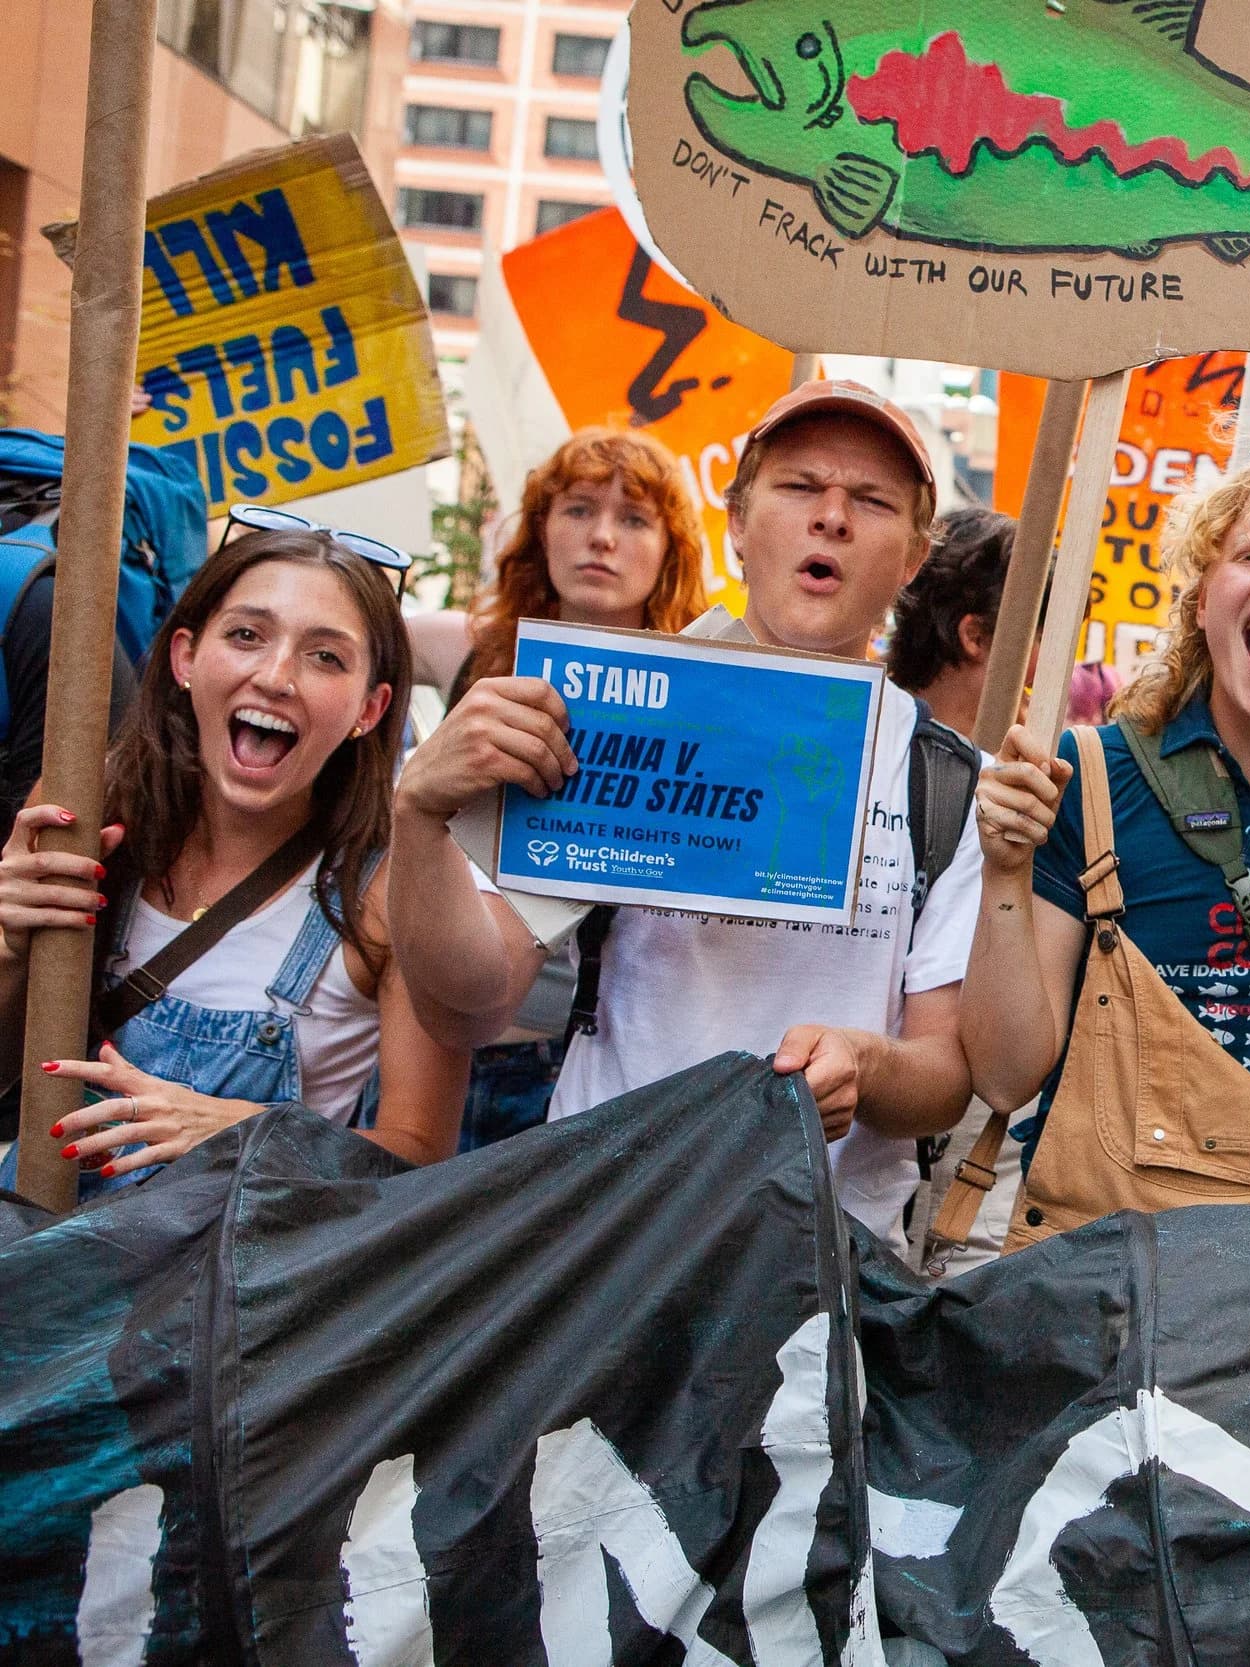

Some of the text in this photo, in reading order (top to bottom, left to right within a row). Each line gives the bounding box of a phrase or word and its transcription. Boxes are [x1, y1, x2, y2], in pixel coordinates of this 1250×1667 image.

[672, 138, 1184, 302] DON'T FRACK WITH OUR FUTURE
[142, 187, 317, 317] KILL
[143, 305, 361, 432] FUELS
[563, 661, 670, 710] STAND
[566, 728, 704, 778] LIANA V.
[553, 769, 764, 823] ITED STATES
[526, 816, 742, 851] CLIMATE RIGHTS NOW!
[566, 843, 597, 858] Our
[566, 857, 608, 873] Trust
[611, 865, 637, 875] Youth
[863, 854, 900, 868] ential
[754, 870, 844, 886] bit.ly/climaterightsnow
[775, 880, 823, 892] #youthvgov
[761, 887, 835, 901] #climaterightsnow
[821, 923, 891, 940] materials
[1155, 964, 1190, 977] AVE
